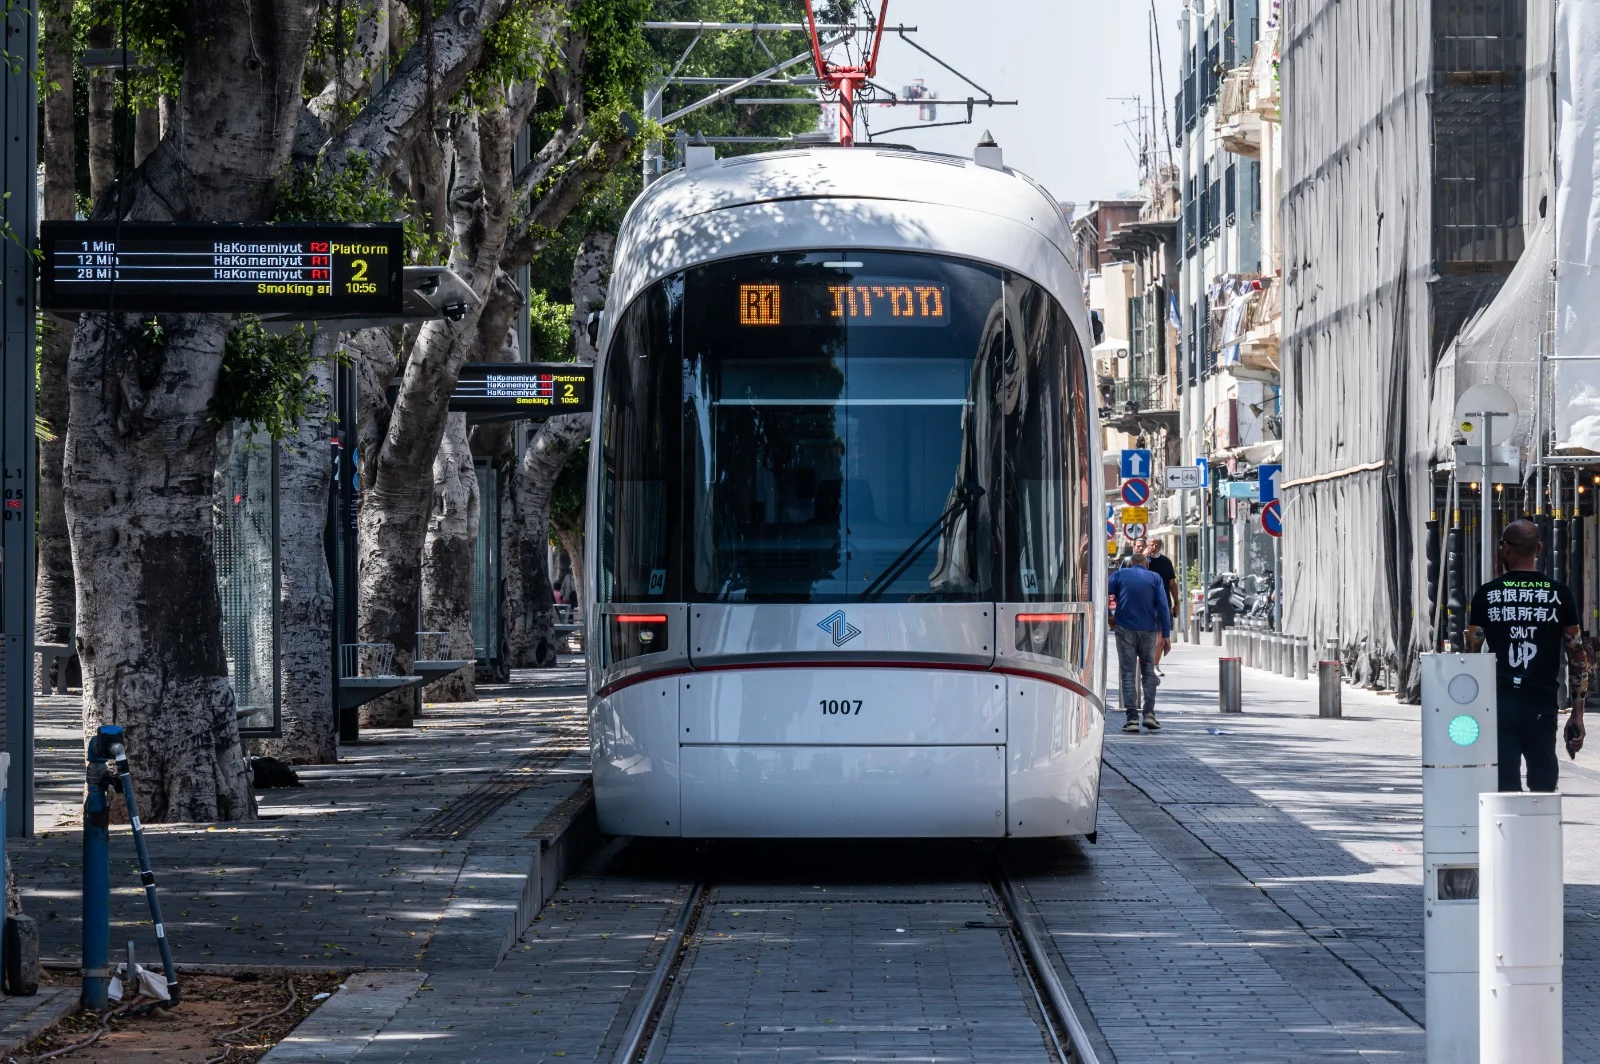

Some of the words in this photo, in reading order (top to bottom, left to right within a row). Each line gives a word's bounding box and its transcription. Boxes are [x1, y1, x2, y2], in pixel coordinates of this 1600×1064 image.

[82, 242, 88, 252] 1
[93, 242, 115, 252] Min
[214, 242, 303, 254] HaKomemiyut
[311, 242, 329, 252] R2
[332, 244, 388, 254] Platform
[78, 255, 93, 265] 12
[96, 255, 119, 265] Min
[214, 256, 303, 268] HaKomemiyut
[312, 256, 328, 266] R1
[78, 268, 93, 279] 28
[96, 268, 119, 279] Min
[214, 269, 303, 281] HaKomemiyut
[312, 269, 328, 279] R1
[351, 259, 368, 281] 2
[257, 284, 314, 296] Smoking
[346, 282, 377, 293] 10:56
[746, 289, 774, 320] R1
[828, 286, 944, 317] ממיות
[564, 384, 574, 397] 2
[516, 397, 549, 405] Smoking
[651, 573, 664, 589] 04
[1487, 588, 1562, 605] 我恨所有人
[1487, 606, 1559, 623] 我恨所有人
[1510, 626, 1538, 640] SHUT
[1508, 640, 1538, 669] UP
[819, 699, 863, 716] 1007
